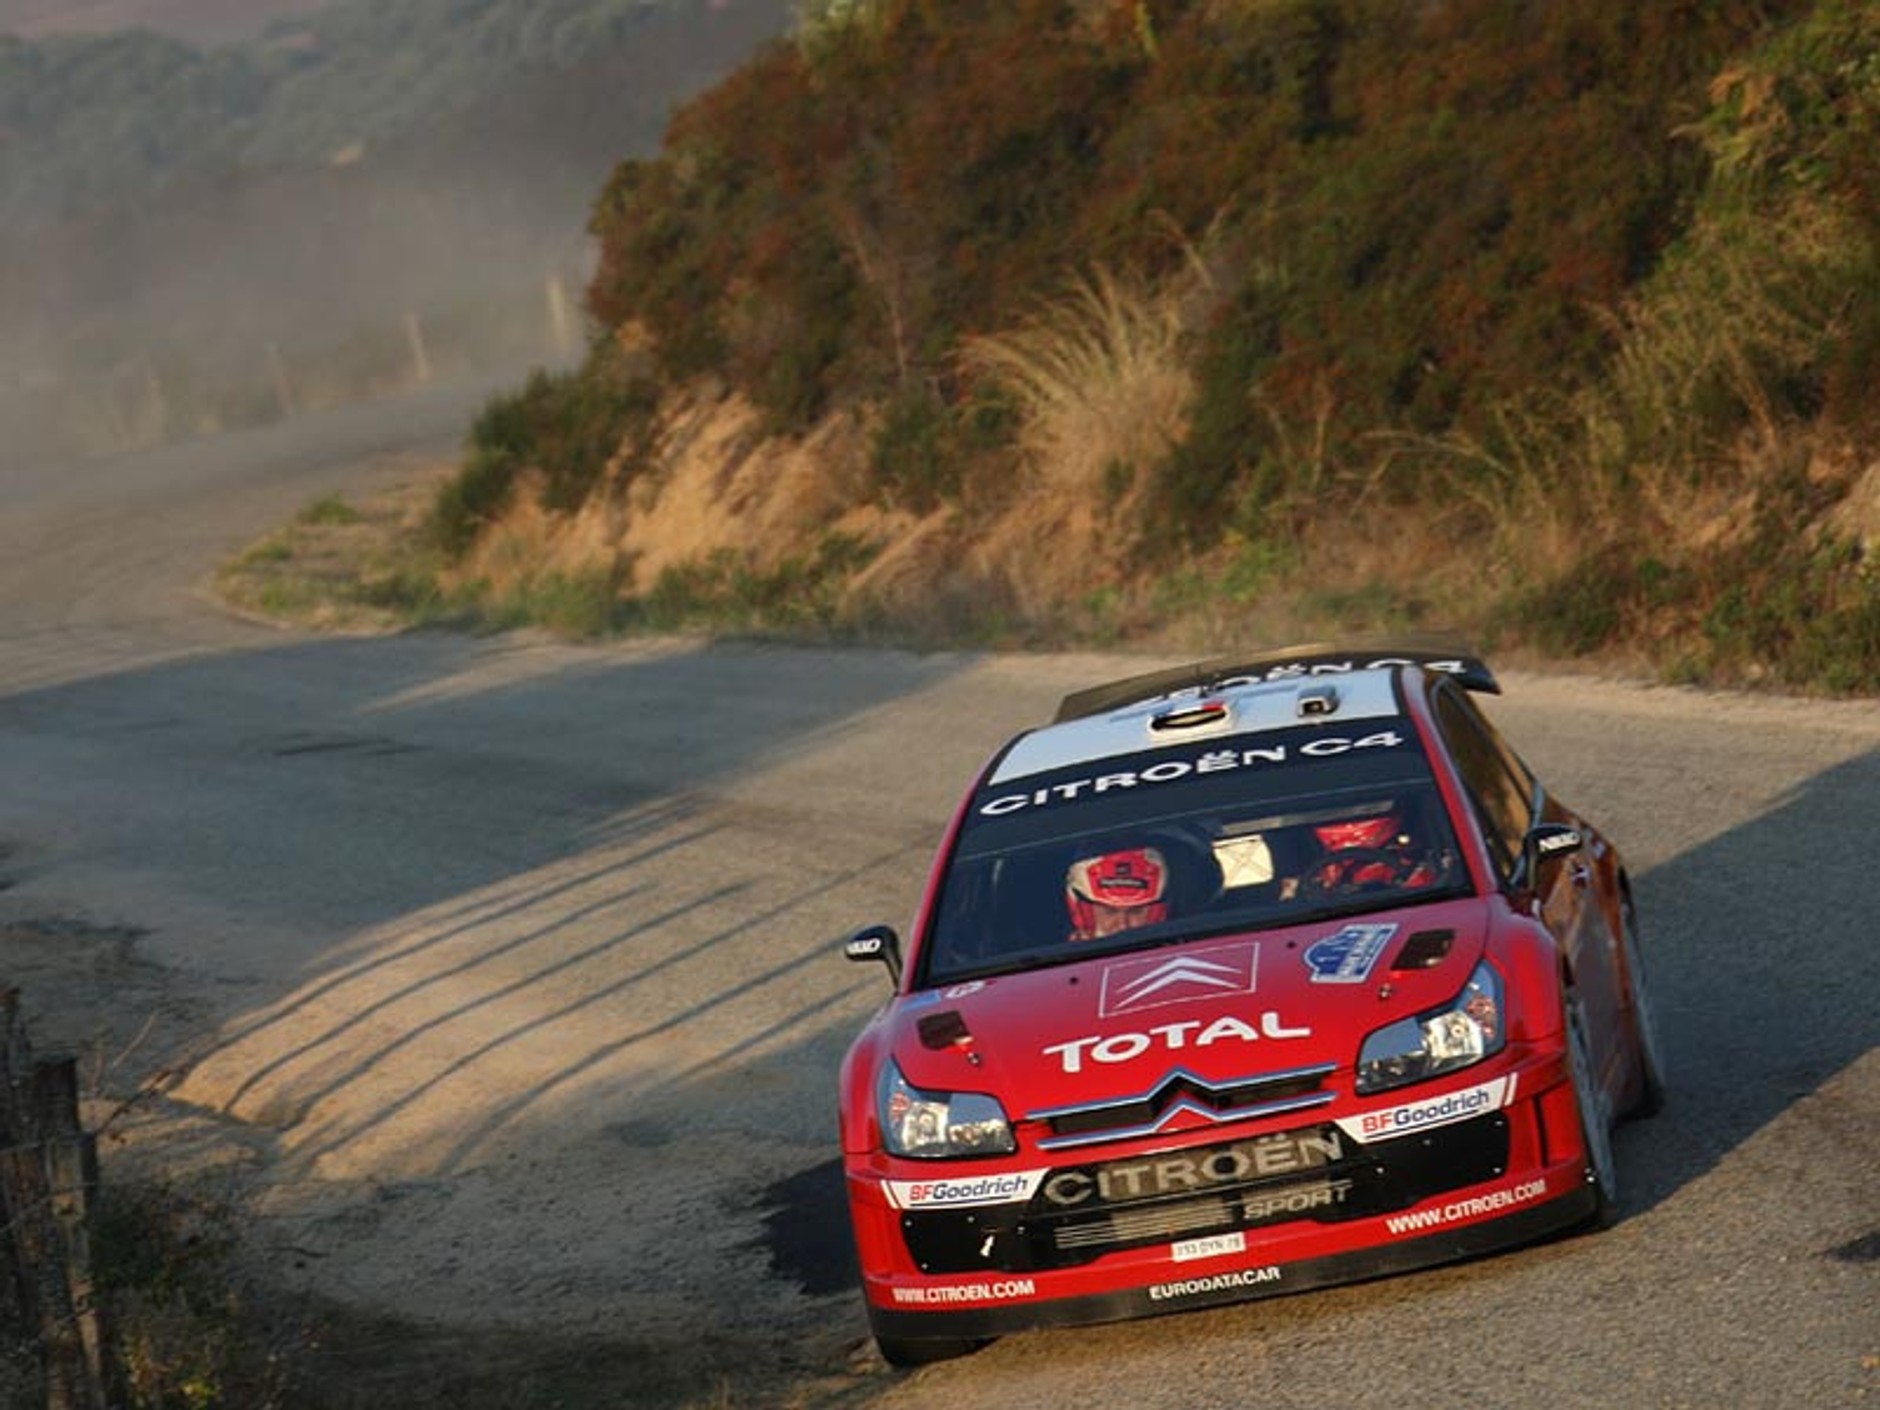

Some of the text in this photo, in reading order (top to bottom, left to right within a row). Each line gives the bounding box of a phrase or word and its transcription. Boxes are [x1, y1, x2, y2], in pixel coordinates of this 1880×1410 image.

[979, 730, 1405, 816] CITROËN C4
[1043, 1011, 1311, 1073] TOTAL
[1362, 1088, 1490, 1133] BFGoodrich
[909, 1175, 1028, 1201] BFGoodrich
[1044, 1131, 1344, 1204] CITROËN
[1243, 1178, 1353, 1220] SPORT
[1386, 1178, 1547, 1234] WWW.CITROEN.COM
[892, 1279, 1036, 1303] WWW.CITROEN.COM
[1149, 1266, 1282, 1299] EURODATACAR
